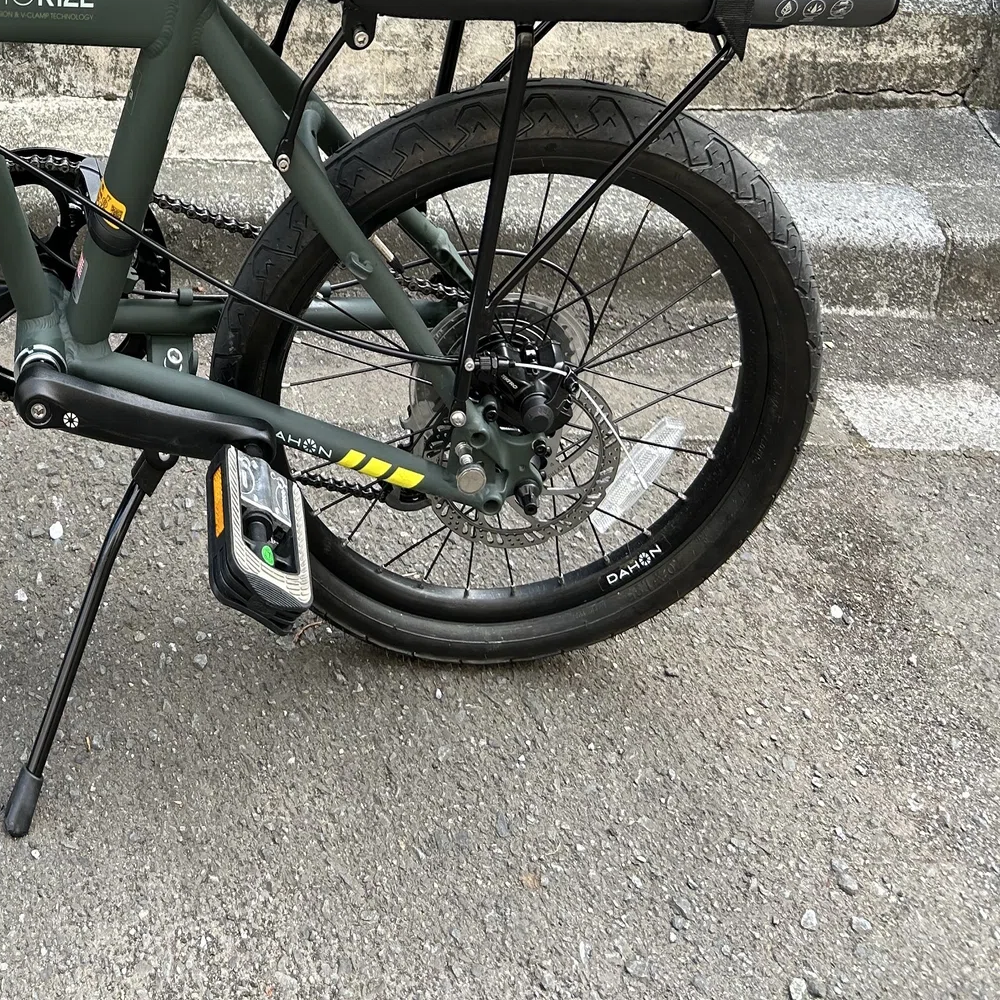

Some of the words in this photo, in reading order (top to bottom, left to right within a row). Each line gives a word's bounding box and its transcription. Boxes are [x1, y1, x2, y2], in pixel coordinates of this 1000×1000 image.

[20, 12, 50, 20] V-CLAMP
[50, 12, 94, 21] TECHNOLOGY
[275, 430, 333, 459] AHON
[606, 544, 662, 585] DAHON
